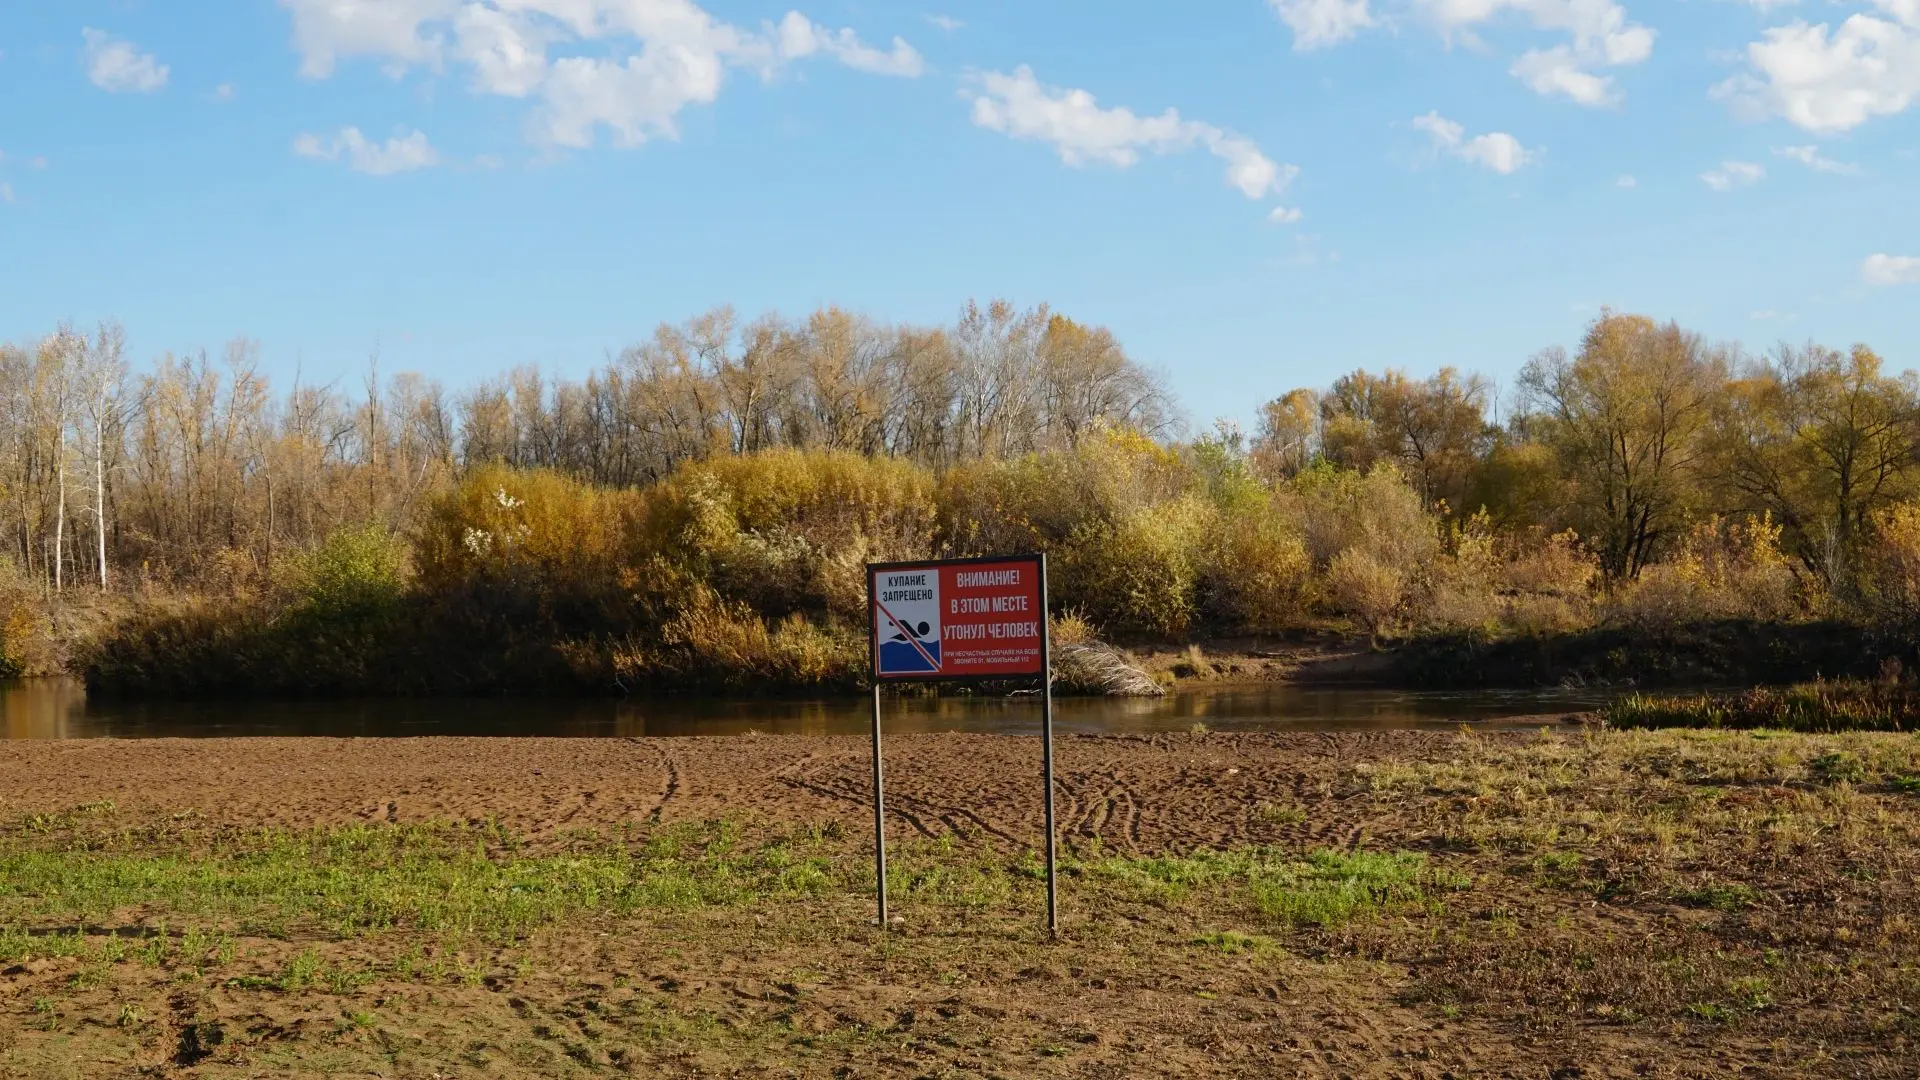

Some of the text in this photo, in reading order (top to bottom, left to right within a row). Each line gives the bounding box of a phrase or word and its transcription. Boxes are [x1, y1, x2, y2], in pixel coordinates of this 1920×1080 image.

[888, 574, 926, 587] КУПАНИЕ
[956, 570, 1020, 588] ВНИМАНИЕ!
[882, 589, 933, 602] ЗАПРЕЩЕНО
[951, 596, 1028, 614] В ЭТОМ МЕСТЕ
[943, 622, 1039, 640] УТОНУЛ ЧЕЛОВЕК
